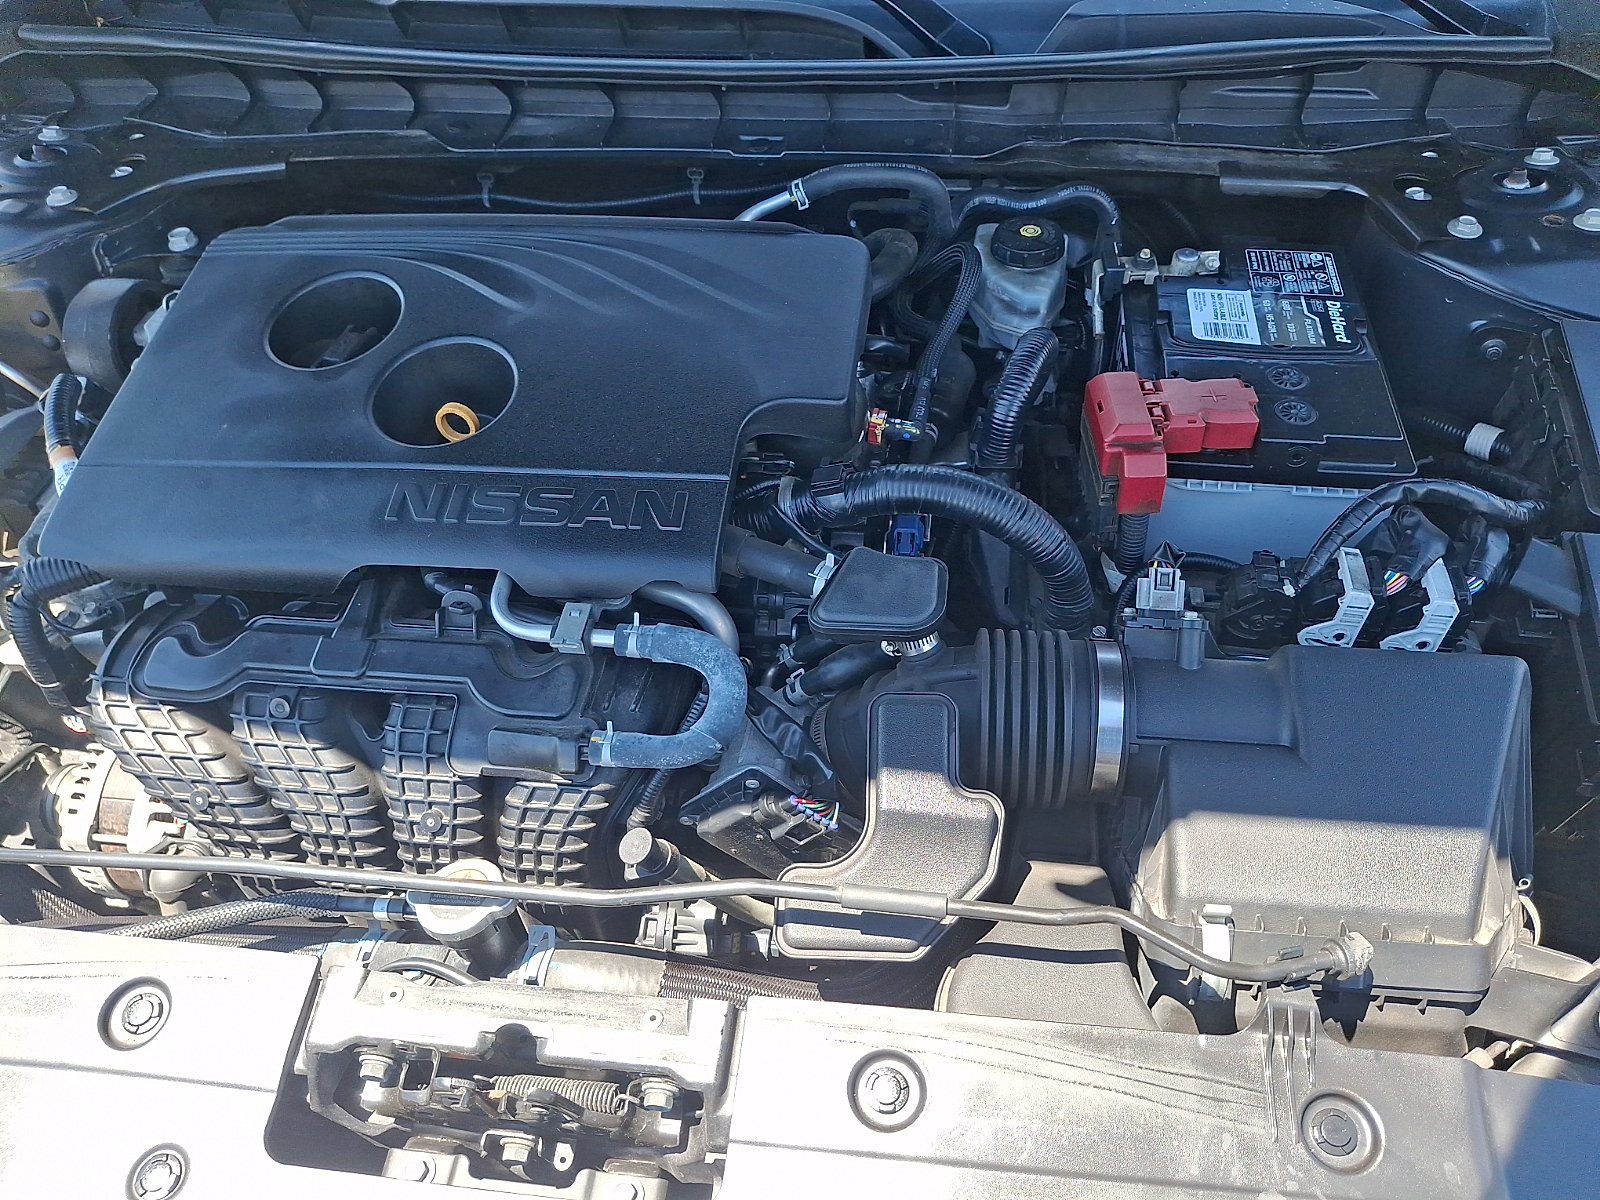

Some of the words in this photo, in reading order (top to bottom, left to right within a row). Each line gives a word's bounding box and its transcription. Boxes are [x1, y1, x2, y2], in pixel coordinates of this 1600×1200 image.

[1303, 318, 1317, 345] PLATINUM
[1325, 300, 1352, 344] DieHard
[384, 482, 689, 531] NISSAN
